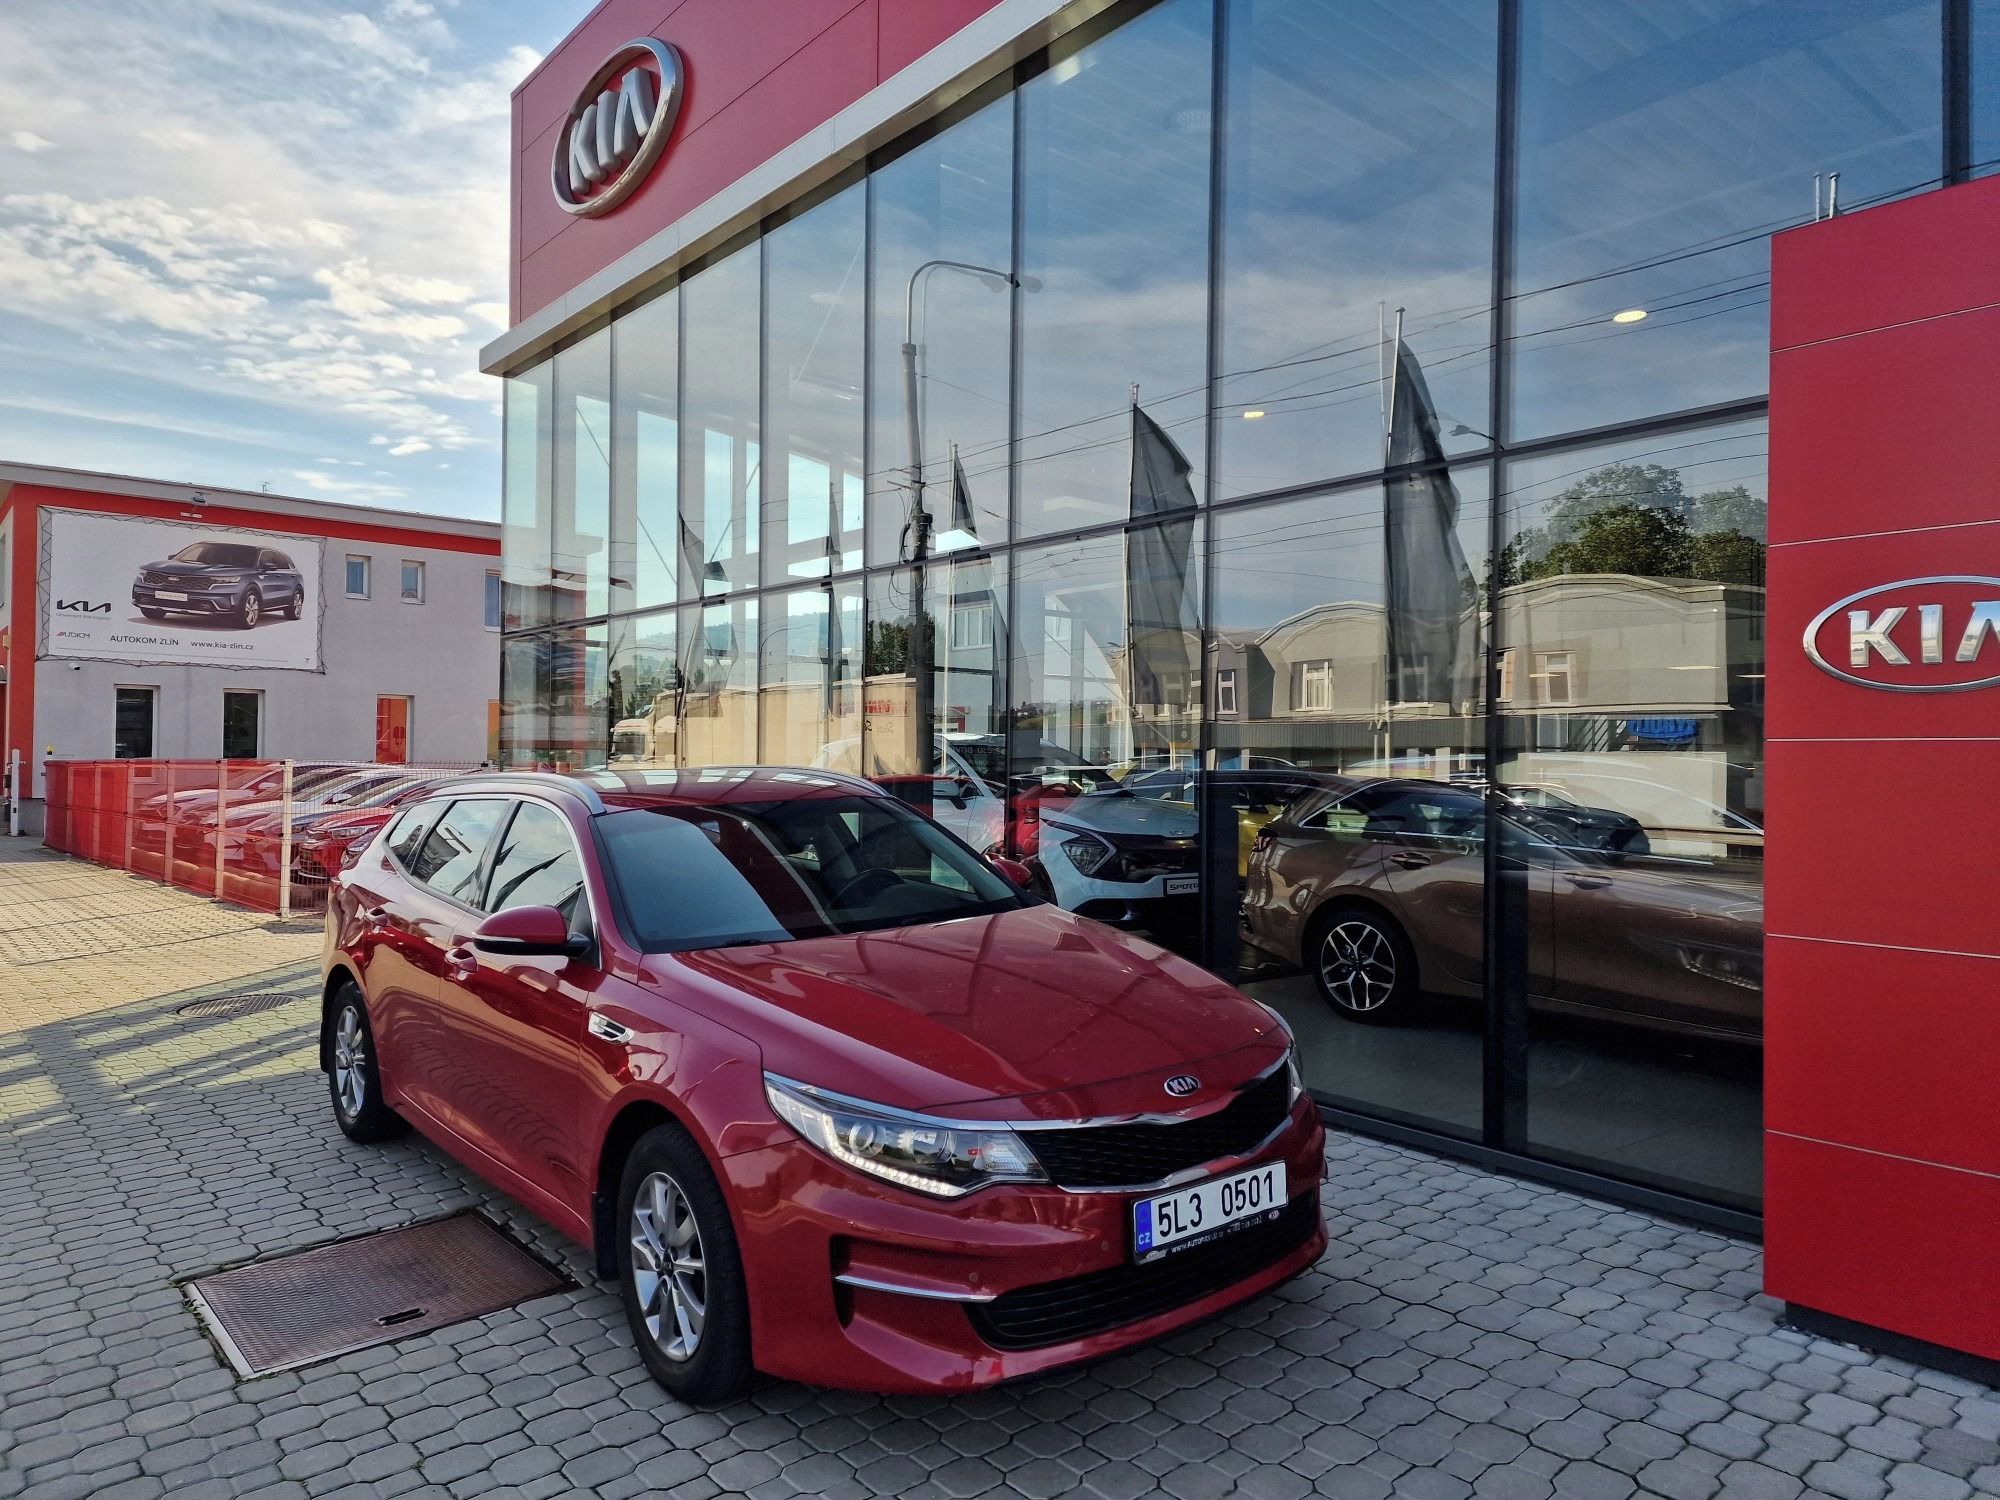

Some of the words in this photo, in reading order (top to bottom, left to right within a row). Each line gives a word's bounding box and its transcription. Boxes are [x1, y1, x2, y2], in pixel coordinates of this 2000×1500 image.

[569, 67, 657, 194] KIA
[109, 634, 157, 645] AUTOKOM
[190, 640, 254, 650] www.kia-zlin.cz
[1168, 1076, 1198, 1093] KIA
[1158, 1193, 1202, 1237] 5L3
[1221, 1170, 1273, 1217] 0501
[1138, 1232, 1151, 1245] CZ
